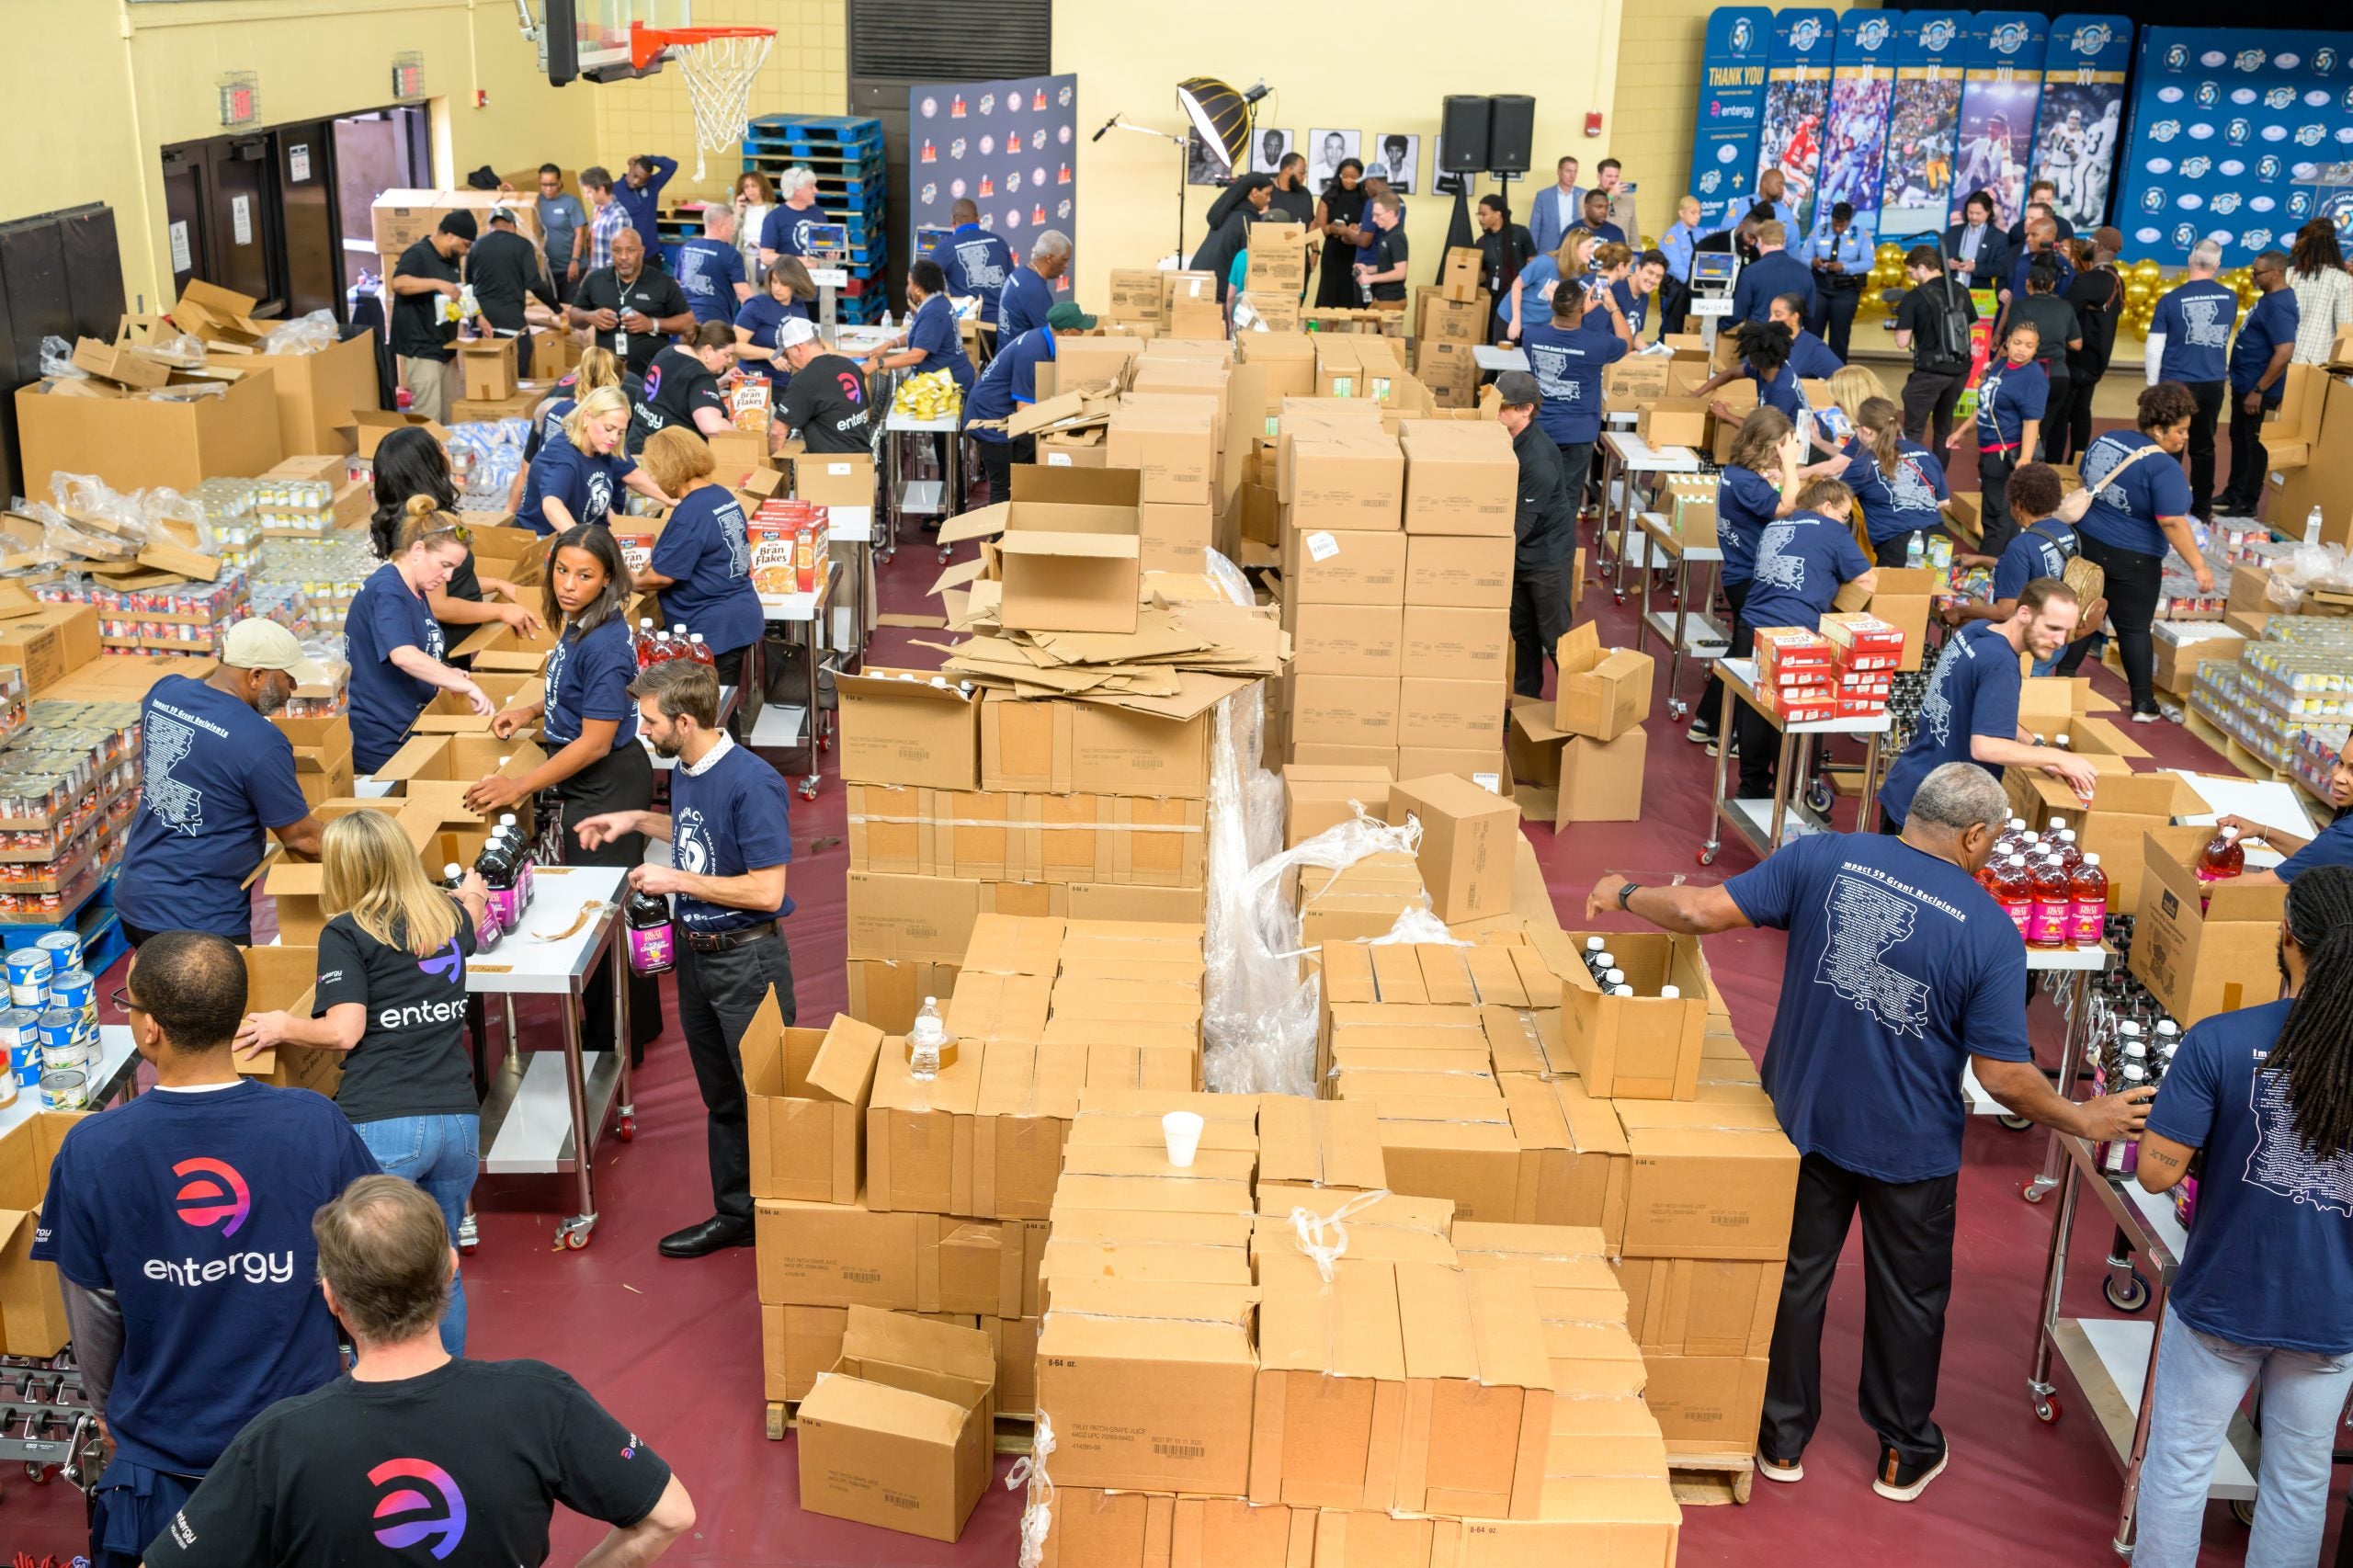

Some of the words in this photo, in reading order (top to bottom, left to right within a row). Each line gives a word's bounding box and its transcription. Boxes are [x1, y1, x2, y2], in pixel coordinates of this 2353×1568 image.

[1709, 67, 1742, 86] THANK
[1744, 66, 1765, 85] YOU
[1927, 64, 1940, 83] IX
[2076, 68, 2095, 85] XV
[1722, 104, 1755, 119] entergy
[736, 398, 763, 408] Flakes
[740, 391, 761, 400] Bran
[634, 401, 663, 429] ntergy
[836, 409, 869, 431] enterg
[587, 471, 607, 487] IMPACT
[624, 554, 642, 562] ran
[760, 547, 784, 555] Bran
[756, 554, 788, 566] Flakes
[152, 698, 170, 711] Impact
[169, 706, 179, 715] 59
[177, 710, 195, 722] Grant
[194, 717, 230, 738] Recipients
[702, 827, 716, 858] LEGACY
[1841, 861, 1871, 875] mpact
[1872, 869, 1886, 881] 59
[1886, 876, 1915, 893] Grant
[1915, 889, 1967, 922] Recipients
[321, 970, 343, 981] entergy
[143, 1251, 293, 1287] entergy
[1049, 1358, 1063, 1367] 8-64
[1109, 1426, 1130, 1434] GRAPE
[1130, 1426, 1146, 1435] JUICE
[176, 1508, 198, 1544] ntergy
